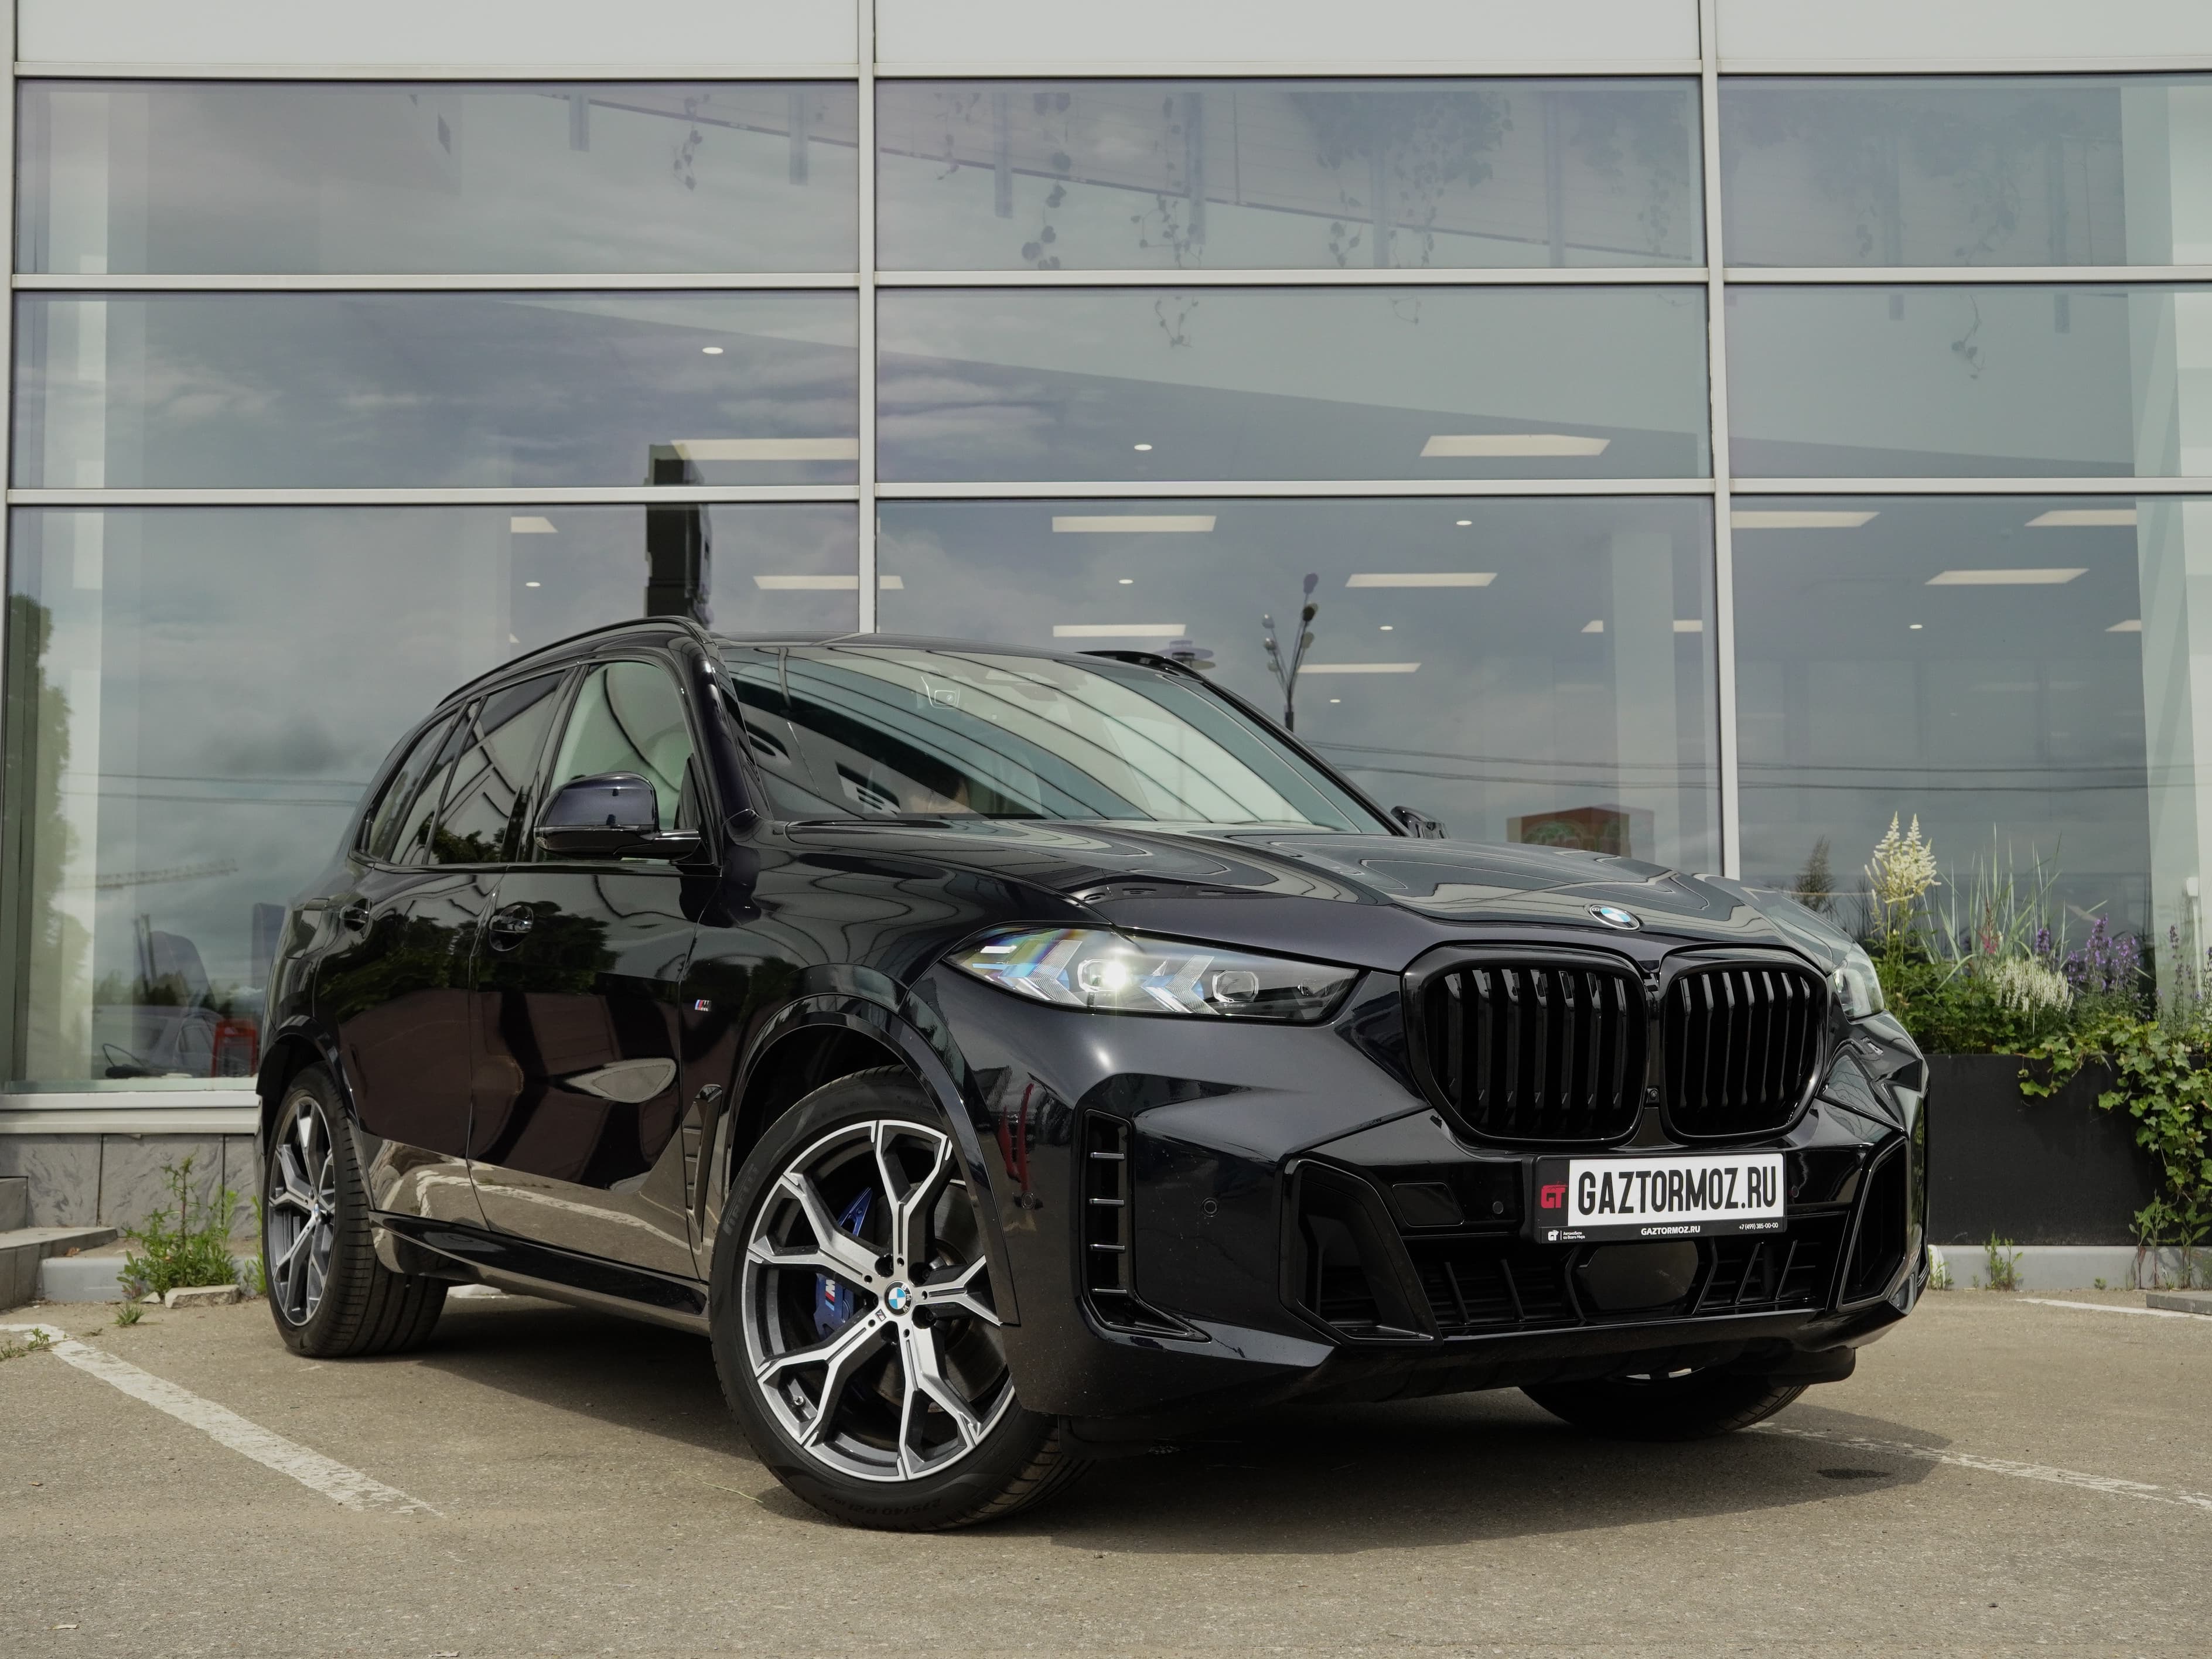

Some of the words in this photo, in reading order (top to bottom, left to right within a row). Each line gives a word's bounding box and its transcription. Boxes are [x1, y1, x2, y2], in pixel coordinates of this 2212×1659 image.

[1578, 1166, 1776, 1216] GAZTORMOZ.RU
[1641, 1226, 1701, 1235] GAZTORMOZ.RU
[902, 1283, 912, 1313] BMW
